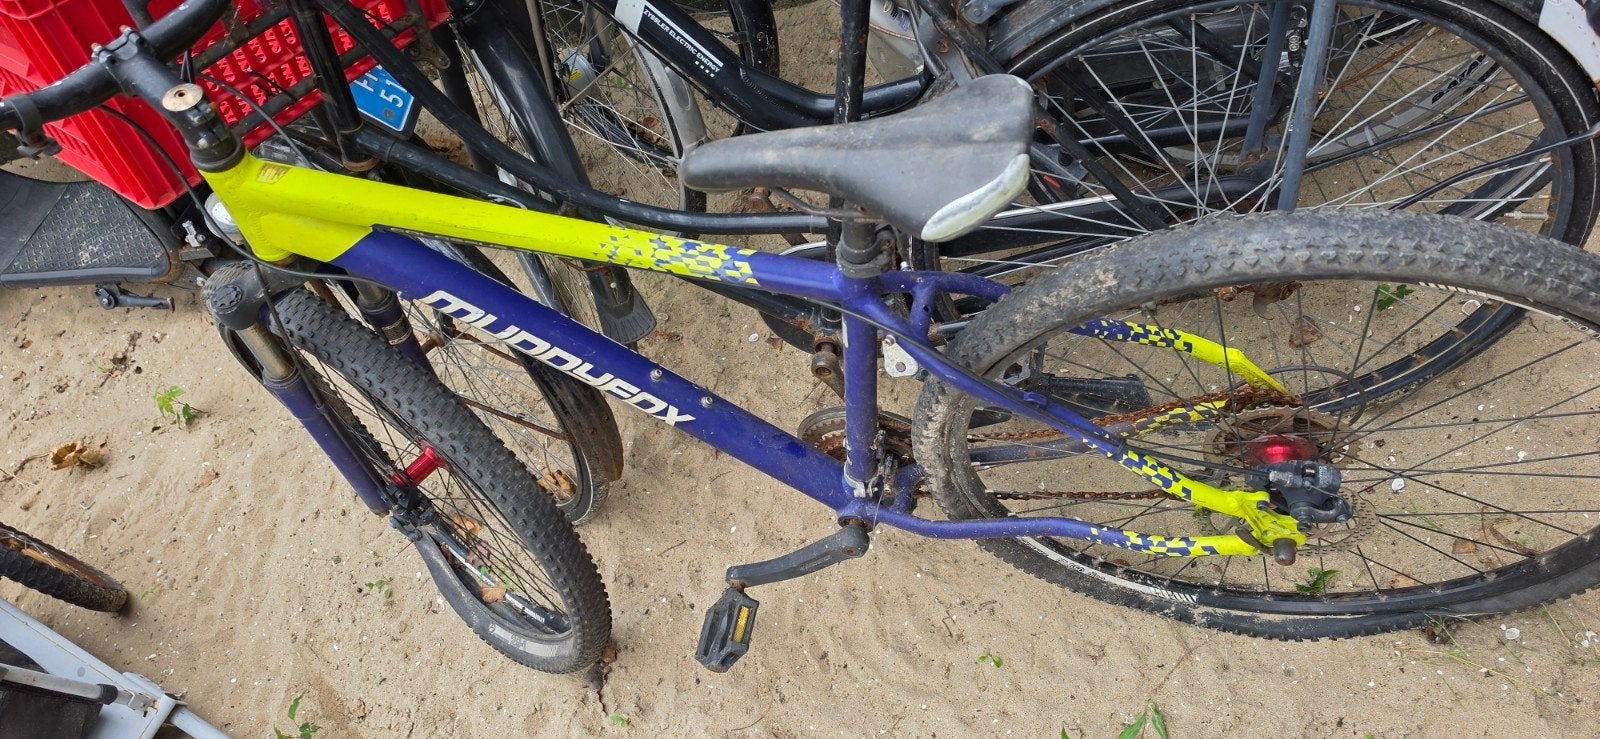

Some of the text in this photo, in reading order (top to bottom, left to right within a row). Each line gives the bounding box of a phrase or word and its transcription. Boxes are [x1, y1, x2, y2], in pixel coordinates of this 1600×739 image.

[669, 29, 698, 55] ELECTRIC
[696, 51, 721, 73] ENERGY
[412, 290, 696, 426] MUDDYFOX
